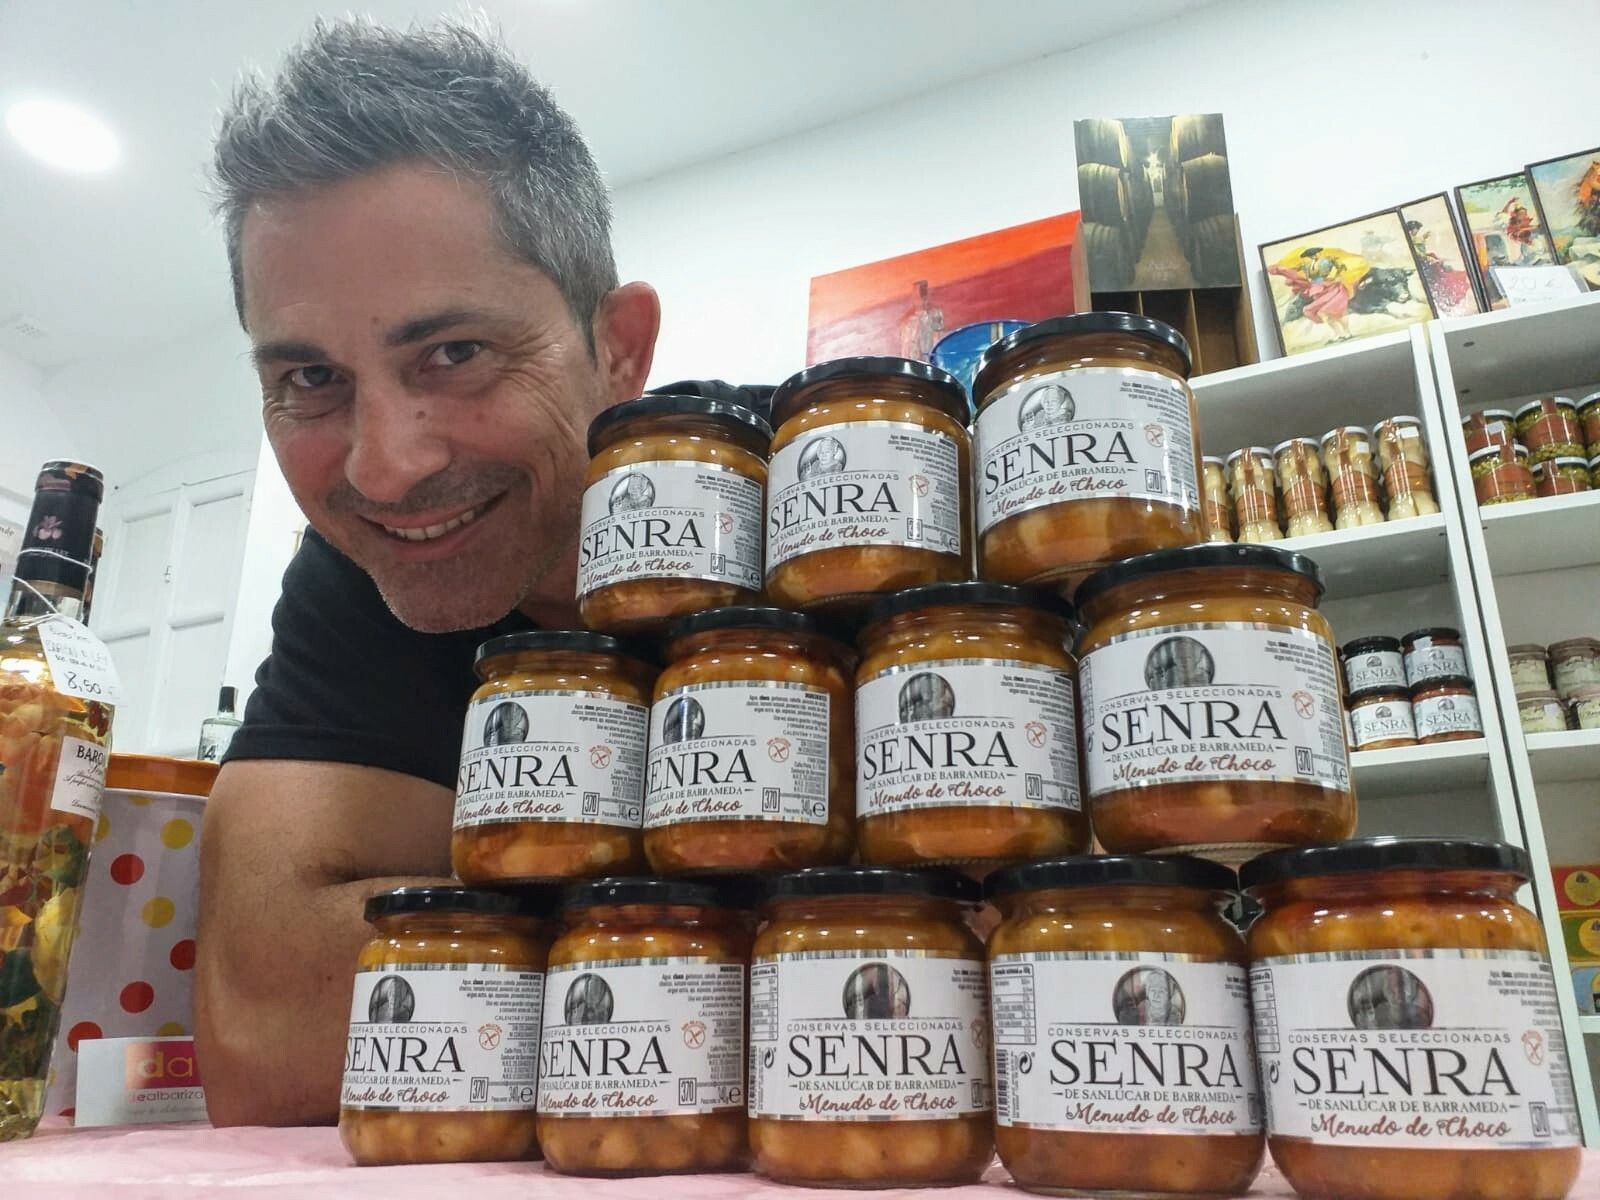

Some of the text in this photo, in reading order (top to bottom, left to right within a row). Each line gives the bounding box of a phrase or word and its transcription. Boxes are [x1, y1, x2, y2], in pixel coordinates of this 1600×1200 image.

[1035, 422, 1135, 439] SELECCIONADAS
[985, 431, 1138, 496] SENRA
[811, 473, 899, 487] SELECCIONADAS
[1046, 471, 1059, 481] DE
[1061, 466, 1126, 478] BARRAMEDA
[992, 477, 1128, 517] Menudo de Choco
[621, 510, 705, 520] SELECCIONADAS
[770, 482, 901, 538] SENRA
[818, 520, 829, 528] DE
[831, 515, 888, 526] BARRAMEDA
[819, 529, 834, 541] de
[838, 525, 889, 539] Choco
[581, 519, 706, 567] SENRA
[627, 560, 641, 572] de
[645, 558, 694, 571] Choco
[1356, 668, 1396, 681] SENRA
[1416, 661, 1460, 674] SENRA
[1099, 688, 1282, 713] CONSERVAS SELECCIONADAS
[1364, 719, 1409, 733] SENRA
[1426, 712, 1471, 725] SENRA
[863, 719, 1015, 744] CONSERVAS SELECCIONADAS
[1102, 700, 1288, 754] SENRA
[494, 745, 580, 754] SELECCIONADAS
[672, 739, 757, 751] SELECCIONADAS
[1111, 754, 1122, 763] DE
[1181, 744, 1195, 753] DE
[1200, 742, 1275, 752] BARRAMEDA
[864, 731, 1018, 781] SENRA
[1298, 750, 1311, 772] 370
[457, 754, 578, 798] SENRA
[647, 749, 757, 794] ENRA
[924, 772, 936, 782] DE
[940, 770, 1006, 780] BARRAMEDA
[1113, 754, 1276, 782] Menudo de Choco
[495, 791, 504, 799] DE
[508, 790, 564, 799] BARRAMEDA
[687, 786, 742, 797] BARRAMEDA
[765, 790, 777, 809] 370
[869, 781, 1006, 807] Menudo de Choco
[495, 801, 511, 814] de
[513, 799, 563, 814] Choco
[676, 800, 690, 814] de
[692, 797, 742, 813] Choco
[378, 1026, 468, 1034] SELECCIONADAS
[576, 1024, 671, 1035] SELECCIONADAS
[786, 1022, 963, 1032] CONSERVAS SELECCIONADAS
[1048, 1027, 1239, 1040] CONSERVAS SELECCIONADAS
[1288, 1033, 1511, 1044] CONSERVAS SELECCIONADAS
[540, 1036, 672, 1079] SENRA
[787, 1032, 967, 1079] SENRA
[1050, 1038, 1243, 1089] SENRA
[1293, 1045, 1521, 1098] SENRA
[380, 1076, 389, 1084] DE
[392, 1075, 451, 1085] BARRAMEDA
[581, 1080, 592, 1089] DE
[595, 1079, 658, 1089] BARRAMEDA
[799, 1080, 813, 1091] DE
[877, 1080, 892, 1091] DE
[895, 1079, 958, 1091] BARRAMEDA
[379, 1087, 394, 1102] de
[398, 1087, 450, 1103] Choco
[473, 1079, 486, 1100] 370
[681, 1080, 694, 1102] 370
[1065, 1088, 1081, 1099] DE
[1153, 1091, 1170, 1102] DE
[1172, 1091, 1236, 1103] BARRAMEDA
[582, 1092, 598, 1108] de
[602, 1091, 658, 1108] Choco
[799, 1092, 876, 1114] Menudo
[879, 1093, 902, 1110] de
[904, 1093, 958, 1111] Choco
[1308, 1099, 1323, 1110] DE
[1400, 1100, 1420, 1112] DE
[1423, 1100, 1508, 1113] BARRAMEDA
[1066, 1102, 1237, 1125] Menudo de Choco
[1311, 1114, 1402, 1138] Menudo
[1406, 1115, 1432, 1137] de
[1437, 1114, 1511, 1138] Choco
